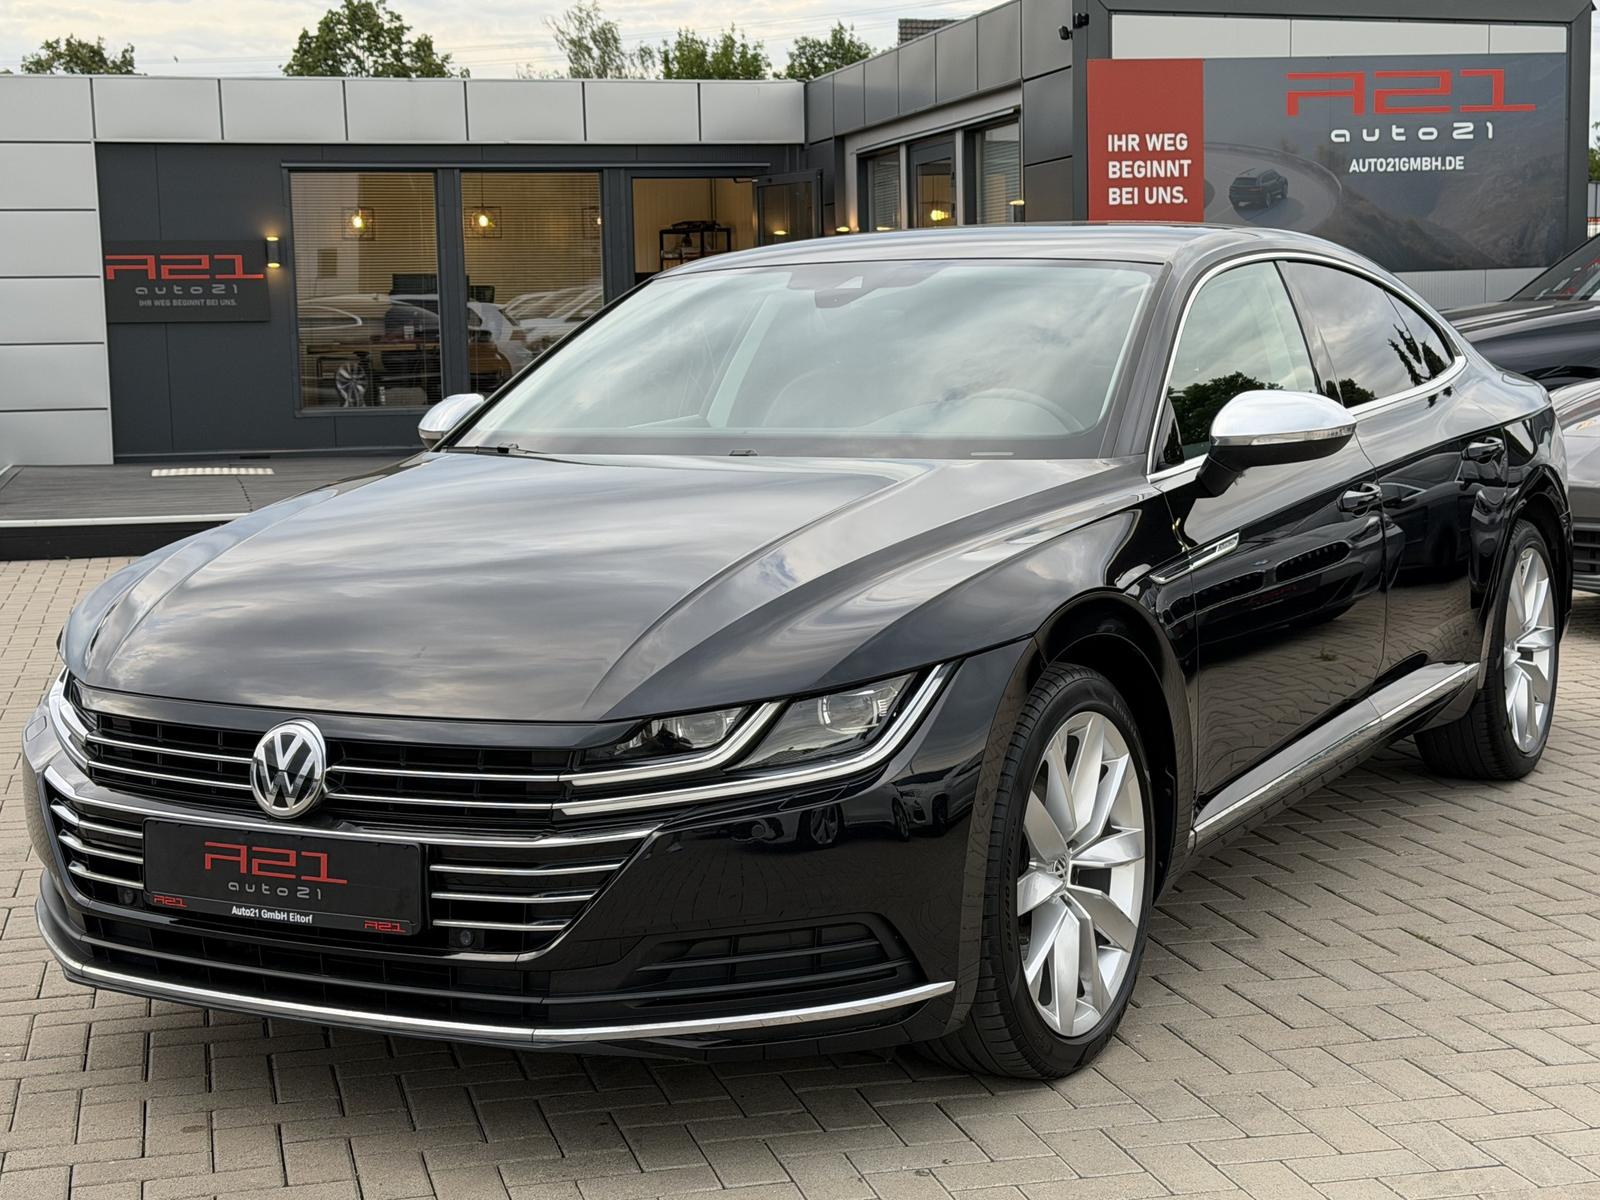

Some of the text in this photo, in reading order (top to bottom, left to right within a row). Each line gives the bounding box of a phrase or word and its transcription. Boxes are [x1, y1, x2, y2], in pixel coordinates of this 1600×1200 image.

[1285, 69, 1537, 116] A21
[1107, 133, 1188, 152] IHR WEG
[1108, 160, 1192, 178] BEGINNT
[1349, 156, 1465, 173] AUTO21GMBH.DE
[1108, 186, 1188, 205] BEI UNS.
[105, 255, 264, 280] A21
[205, 841, 347, 884] A21
[231, 905, 313, 924] Auto21 GmbH Eitorf
